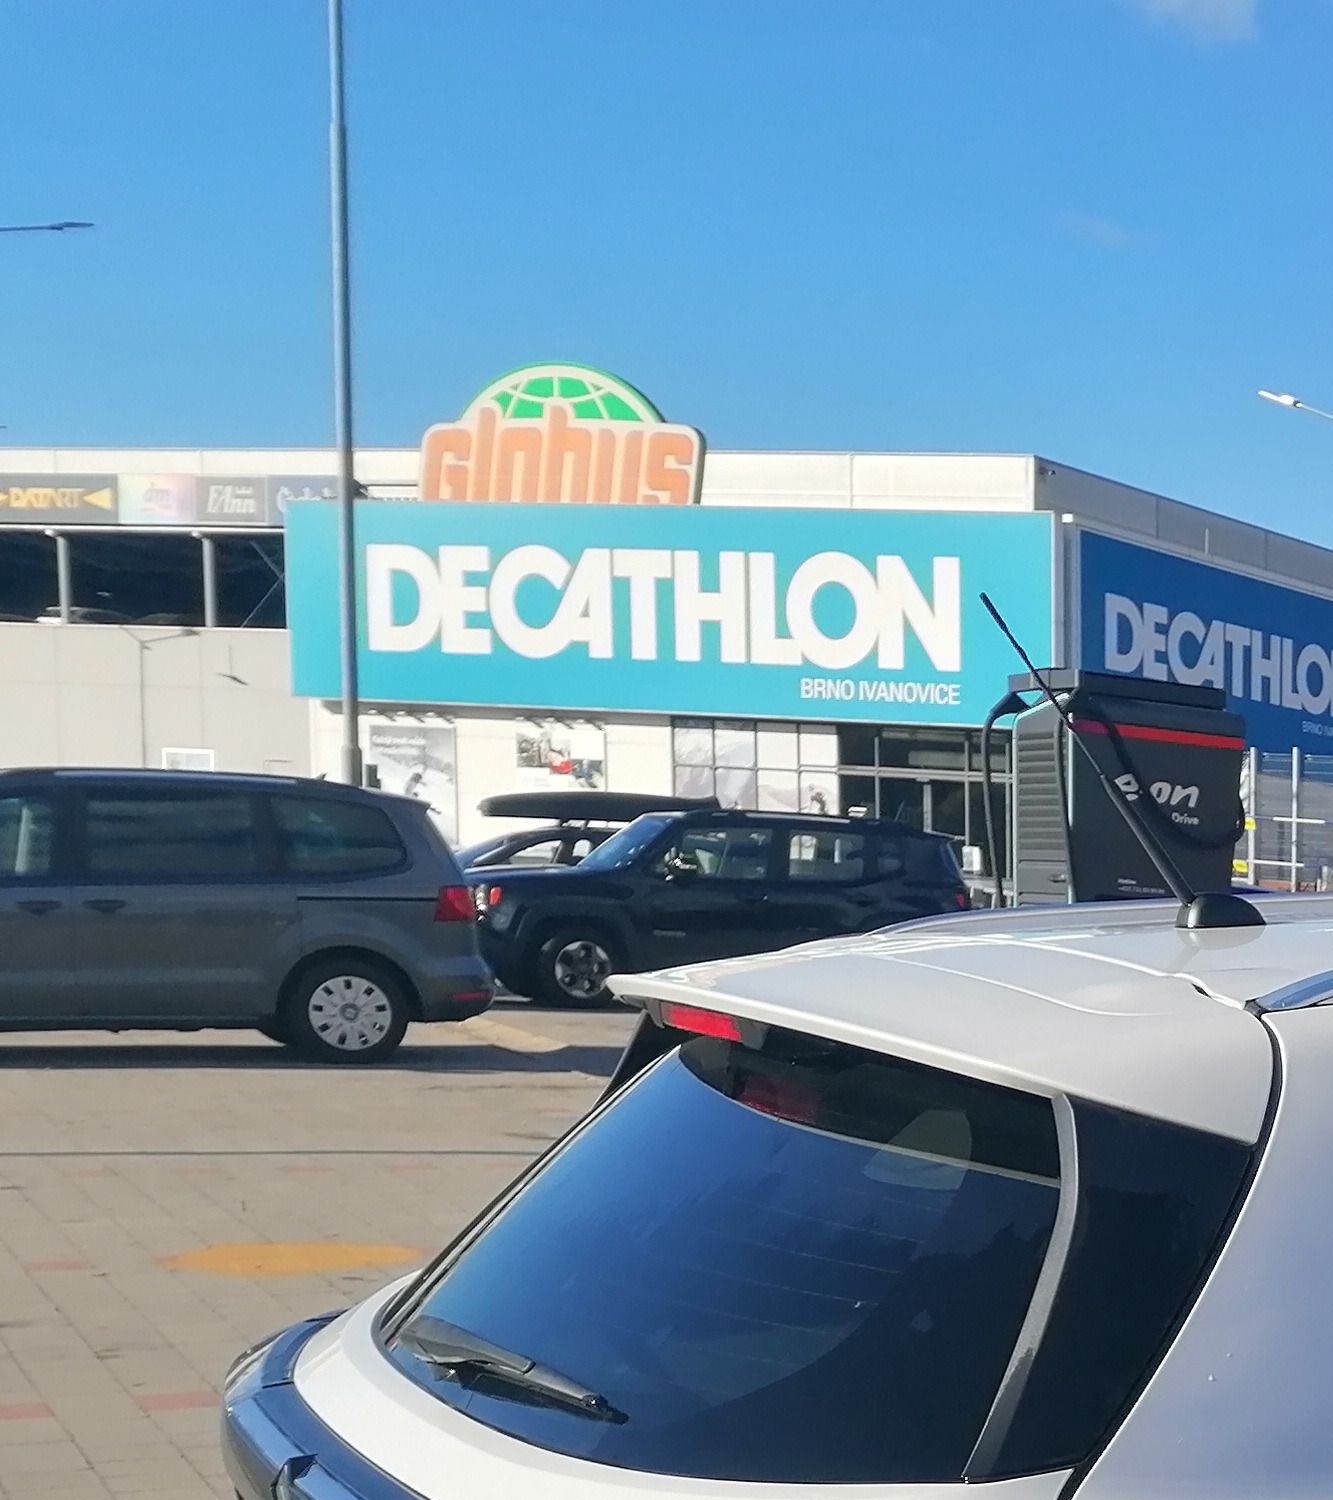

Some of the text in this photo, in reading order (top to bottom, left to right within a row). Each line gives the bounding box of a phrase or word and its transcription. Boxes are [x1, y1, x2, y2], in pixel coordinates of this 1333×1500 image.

[424, 405, 694, 504] Globus
[366, 543, 961, 672] DECATHLON
[800, 678, 961, 705] BRNO IVANOVICE
[1171, 812, 1200, 825] Drive
